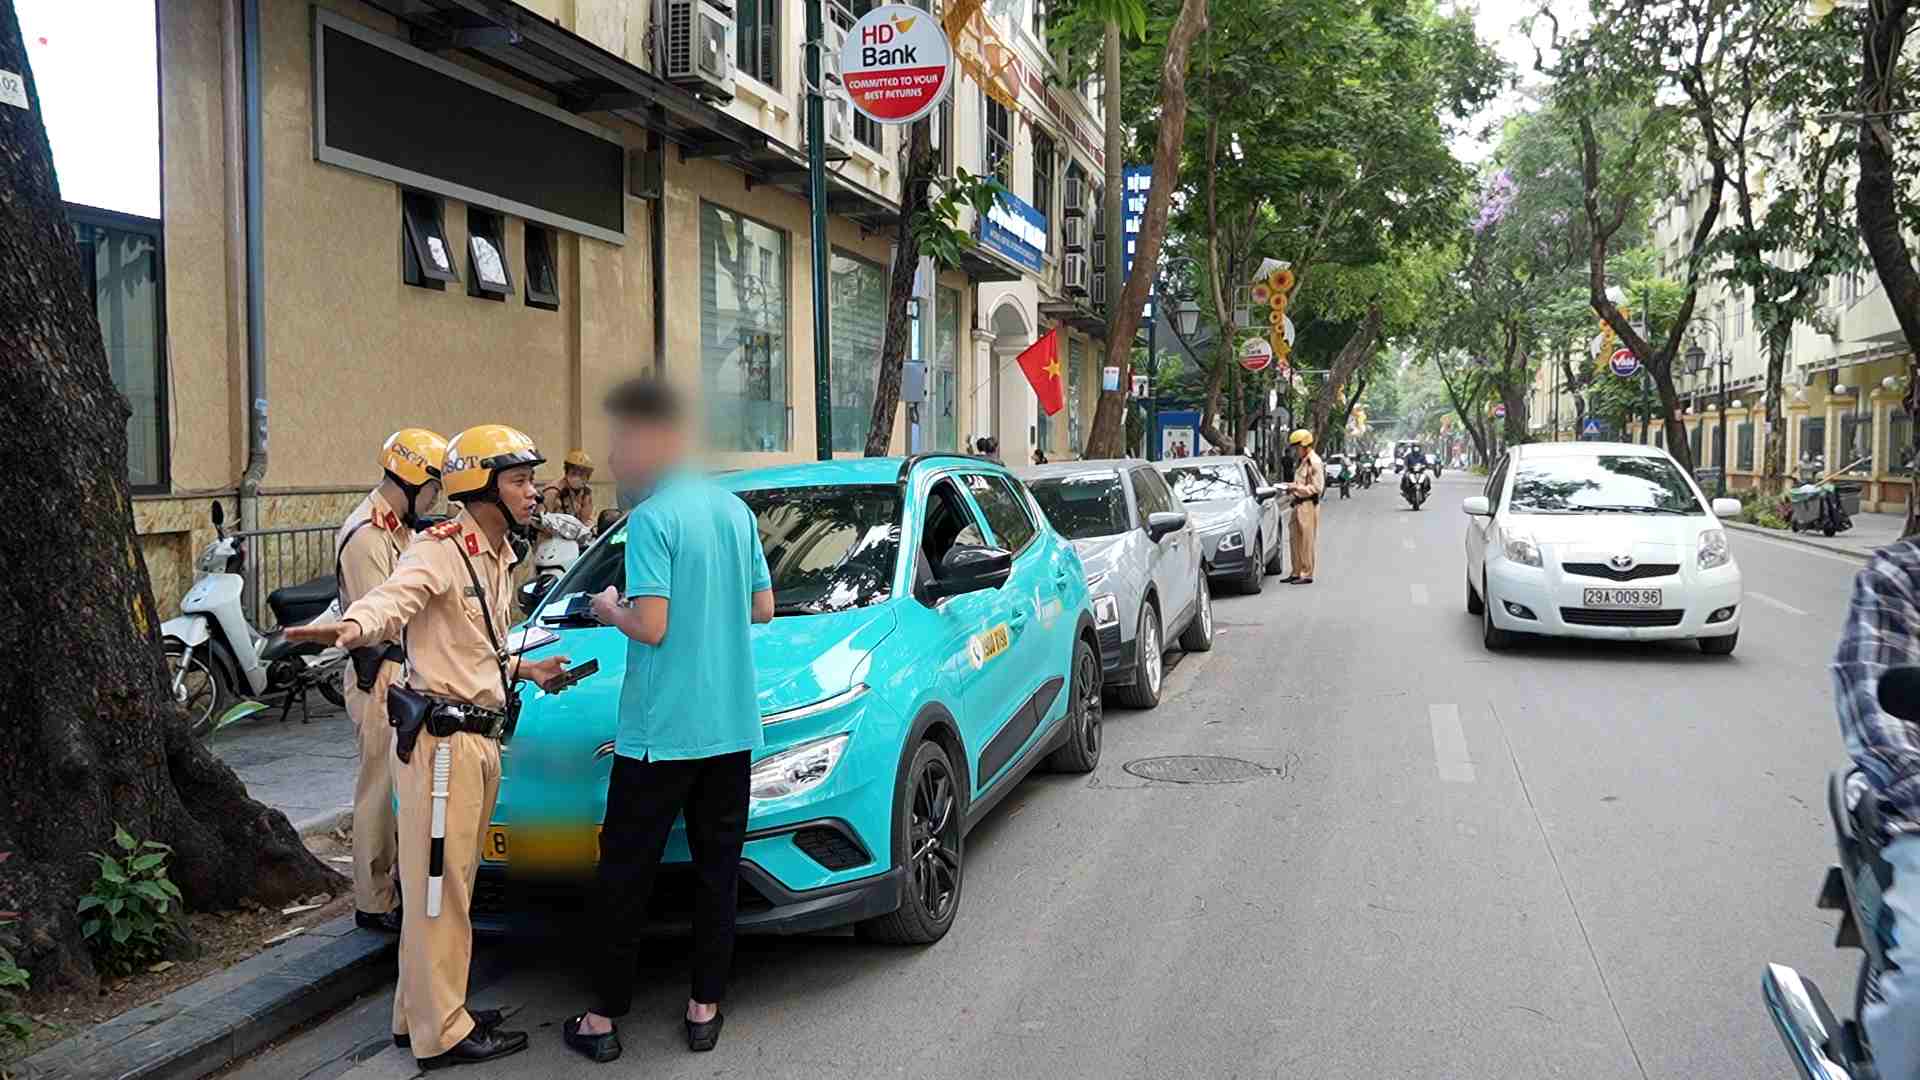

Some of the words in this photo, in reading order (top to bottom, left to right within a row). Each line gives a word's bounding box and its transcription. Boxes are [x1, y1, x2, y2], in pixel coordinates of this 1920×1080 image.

[862, 24, 894, 45] HD
[862, 44, 917, 67] Bank
[848, 78, 899, 89] COMMITTED
[900, 76, 913, 86] TO
[914, 74, 938, 84] YOUR
[864, 91, 883, 100] BEST
[885, 88, 922, 98] RETURNS
